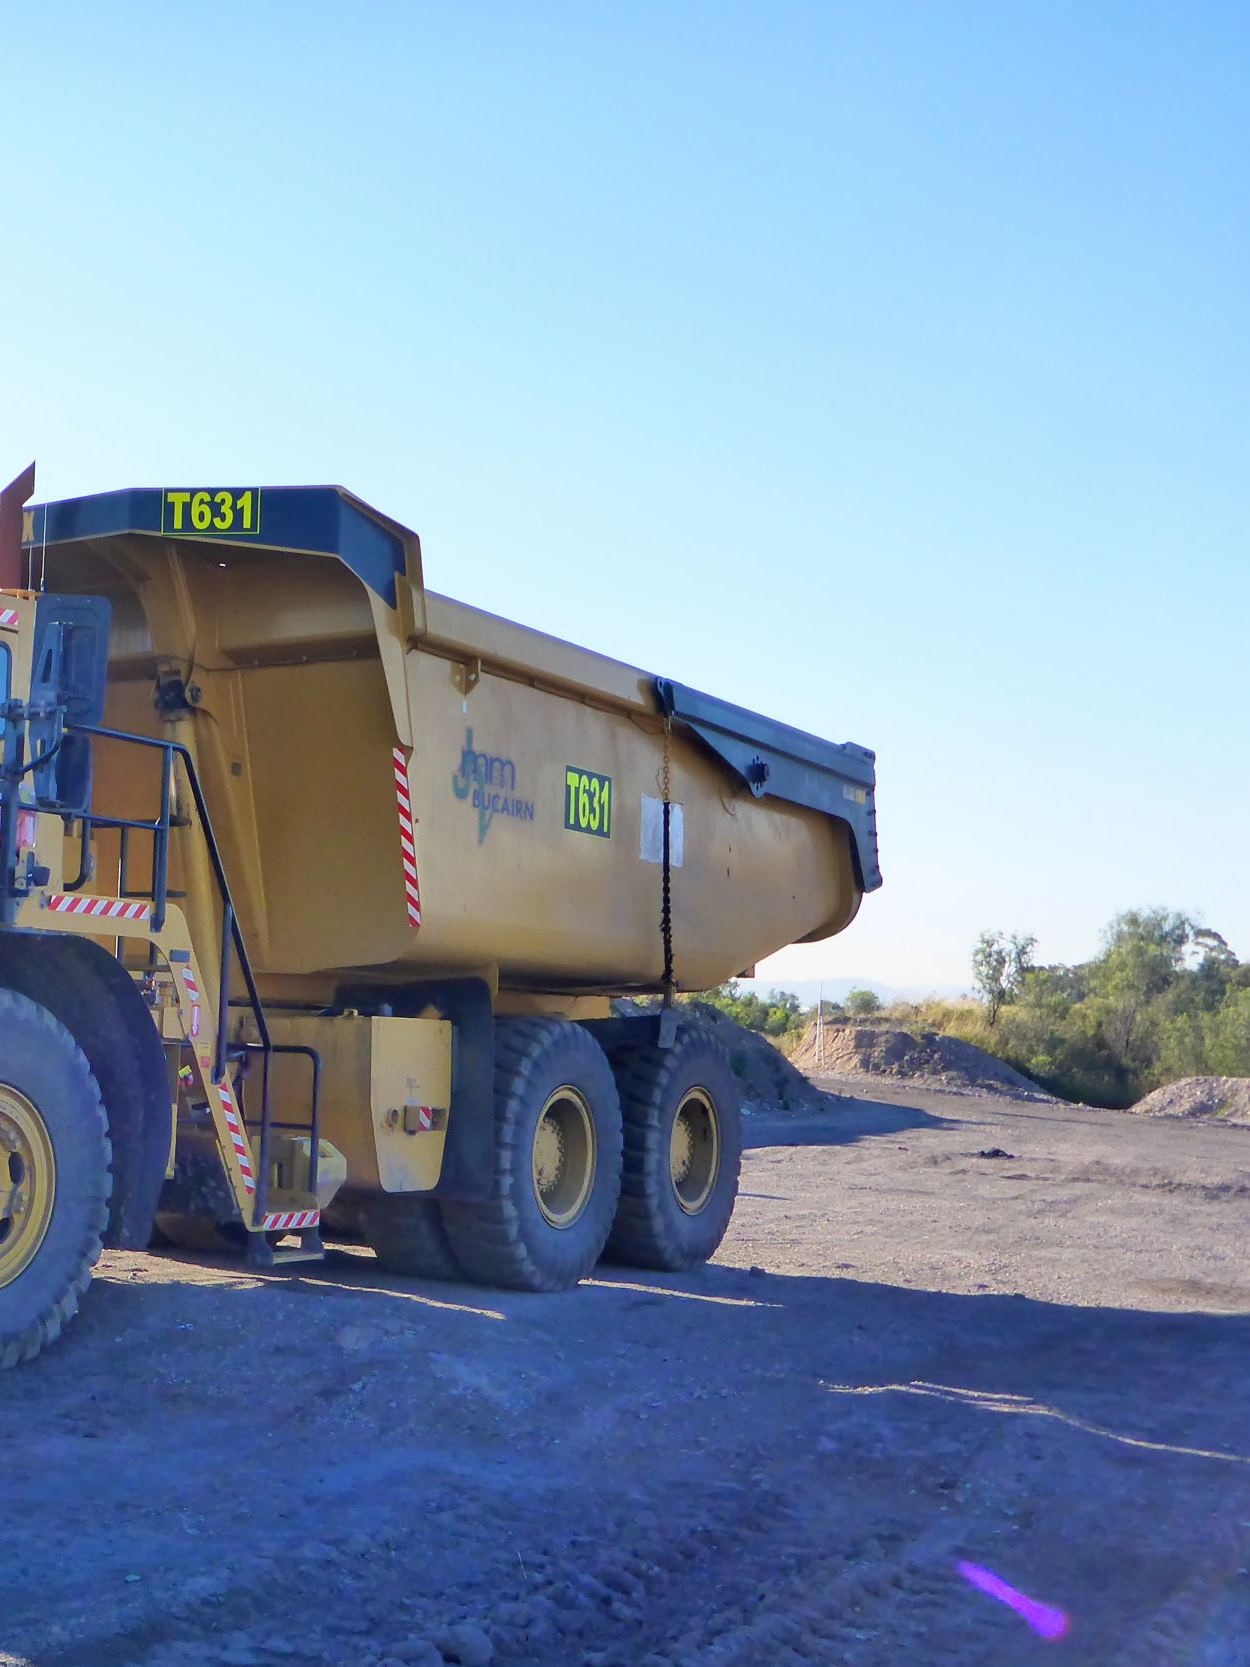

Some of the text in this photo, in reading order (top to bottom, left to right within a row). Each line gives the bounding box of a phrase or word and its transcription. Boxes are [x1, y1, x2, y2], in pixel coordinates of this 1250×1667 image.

[167, 490, 252, 530] T631
[472, 789, 534, 822] BUCAIRN
[566, 771, 609, 833] T631
